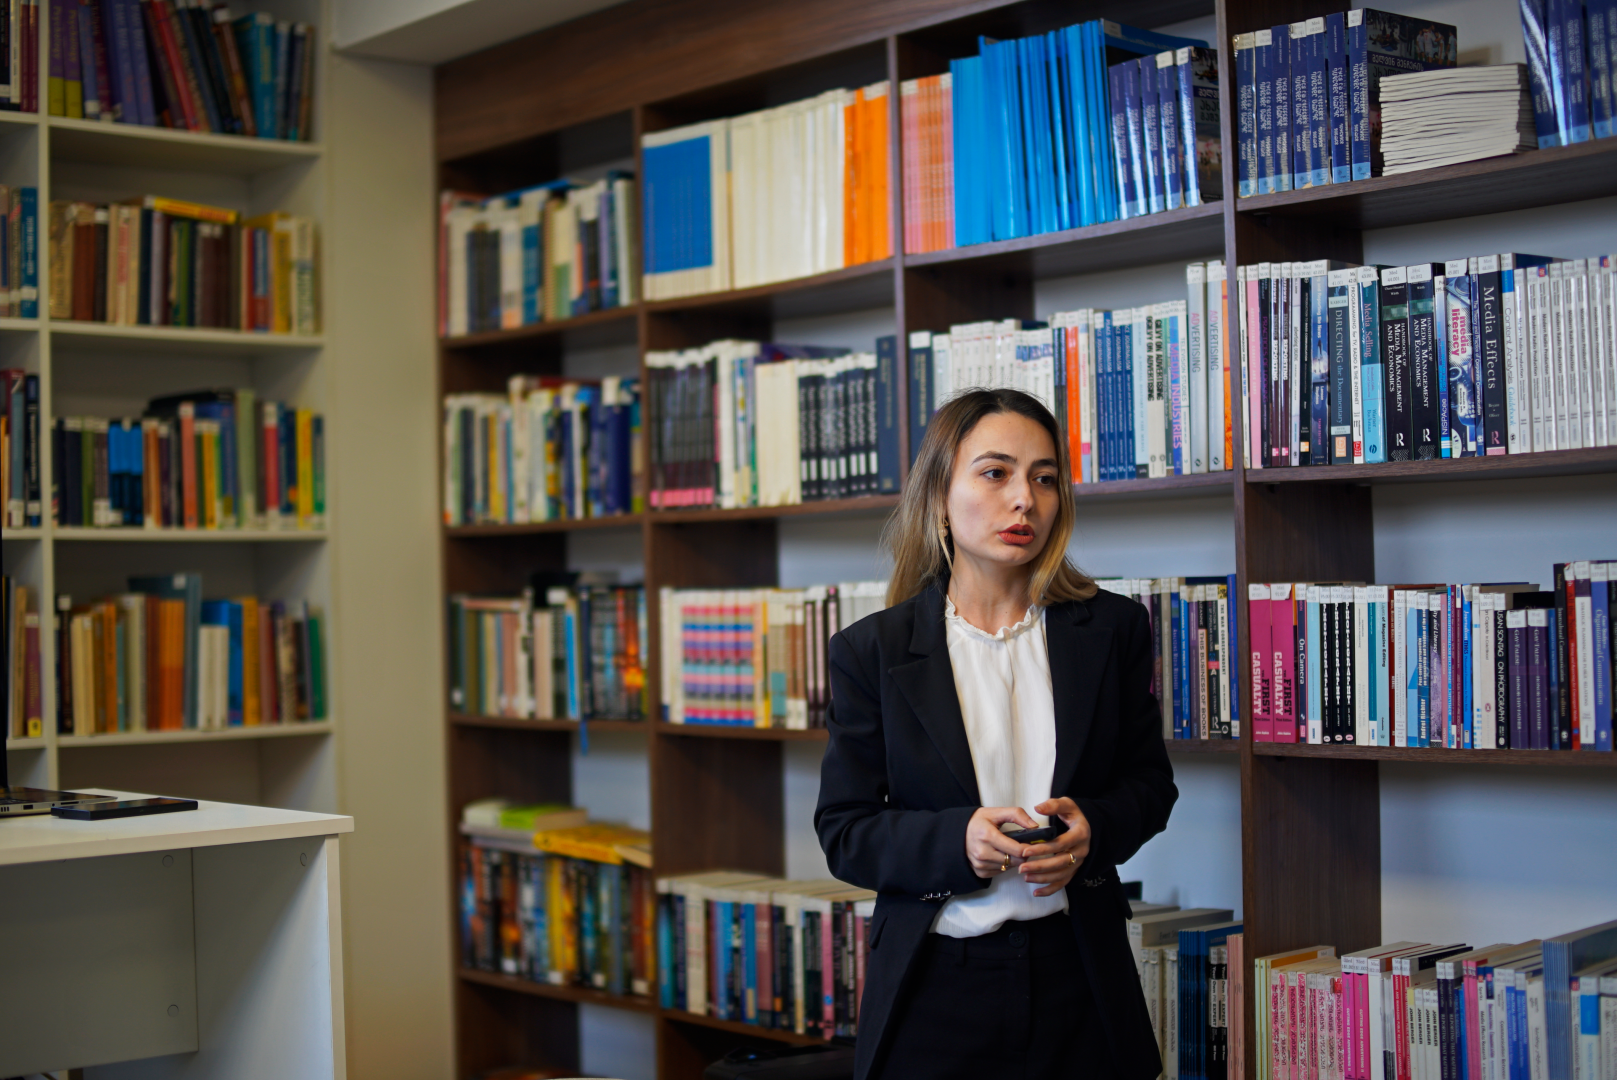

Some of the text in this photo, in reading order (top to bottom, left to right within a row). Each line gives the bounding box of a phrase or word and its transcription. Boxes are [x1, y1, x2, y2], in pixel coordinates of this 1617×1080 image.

[1146, 343, 1154, 353] ON
[1156, 342, 1162, 352] ON
[1191, 313, 1201, 373] ADVERTISING
[1210, 310, 1218, 370] ADVERTISING
[1365, 331, 1374, 358] Selling
[1452, 309, 1460, 356] literacy
[1460, 316, 1468, 354] media
[1483, 286, 1497, 388] Media Effects
[1263, 357, 1268, 366] OF
[1505, 347, 1513, 384] Analysis
[1170, 343, 1182, 449] MEDIA INDUSTRIES
[1508, 387, 1516, 426] Guidebook
[1299, 639, 1305, 650] On
[1252, 652, 1261, 715] CASUALTY
[1274, 652, 1283, 715] CASUALTY
[1498, 662, 1504, 674] ON
[1201, 695, 1206, 705] OF
[1262, 679, 1270, 715] FIRST
[1283, 679, 1292, 715] FIRST
